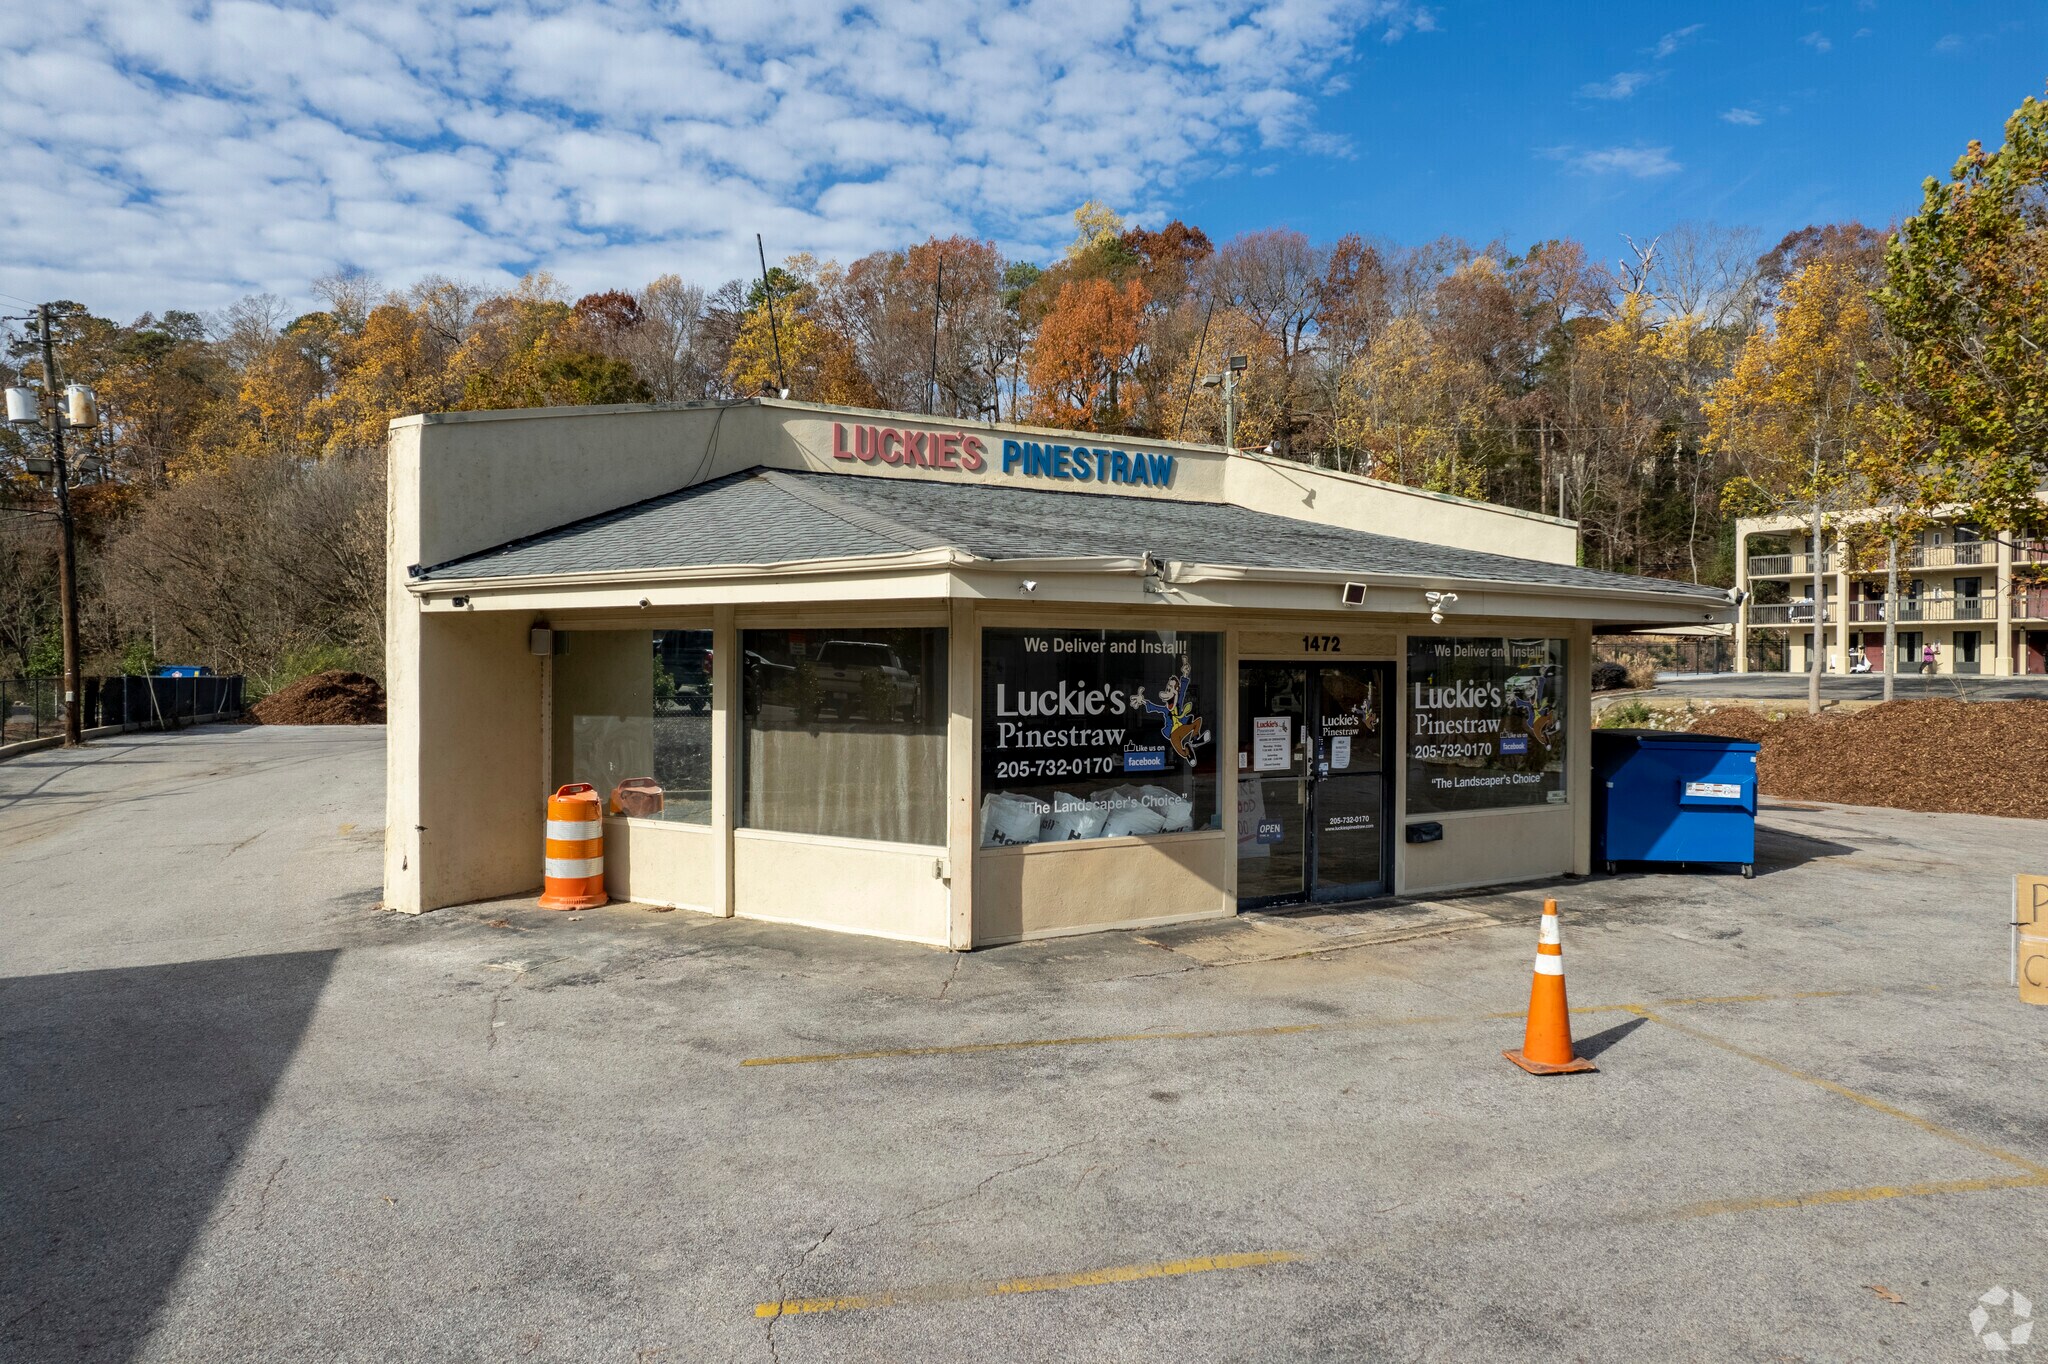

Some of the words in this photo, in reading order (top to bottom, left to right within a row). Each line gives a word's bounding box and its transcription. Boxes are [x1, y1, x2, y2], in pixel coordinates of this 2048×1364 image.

[832, 422, 983, 470] LUCKIE'S
[1002, 438, 1175, 486] PINESTRAW
[1024, 637, 1049, 653] We
[1053, 637, 1106, 653] Deliver
[1109, 639, 1137, 654] and
[1141, 639, 1187, 655] Install!
[1302, 636, 1341, 652] 1472
[1434, 644, 1451, 657] We
[1454, 644, 1489, 657] Deliver
[1492, 645, 1509, 657] and
[996, 680, 1126, 717] Luckie's
[1415, 679, 1501, 709] Luckie's
[1322, 713, 1359, 727] Luckie's
[1414, 713, 1501, 736] Pinestraw
[996, 721, 1126, 749] Pinestraw
[1322, 727, 1360, 737] Pinestraw
[1136, 744, 1148, 752] Like
[1414, 742, 1492, 758] 205-732-0170
[1502, 742, 1525, 750] facebook
[996, 757, 1113, 778] 205-732-0170
[1128, 756, 1161, 767] facebook
[1454, 774, 1511, 788] Landscaper's
[1054, 796, 1138, 814] Landscaper's
[1329, 815, 1370, 825] 205-732-0170
[1259, 823, 1281, 834] OPEN
